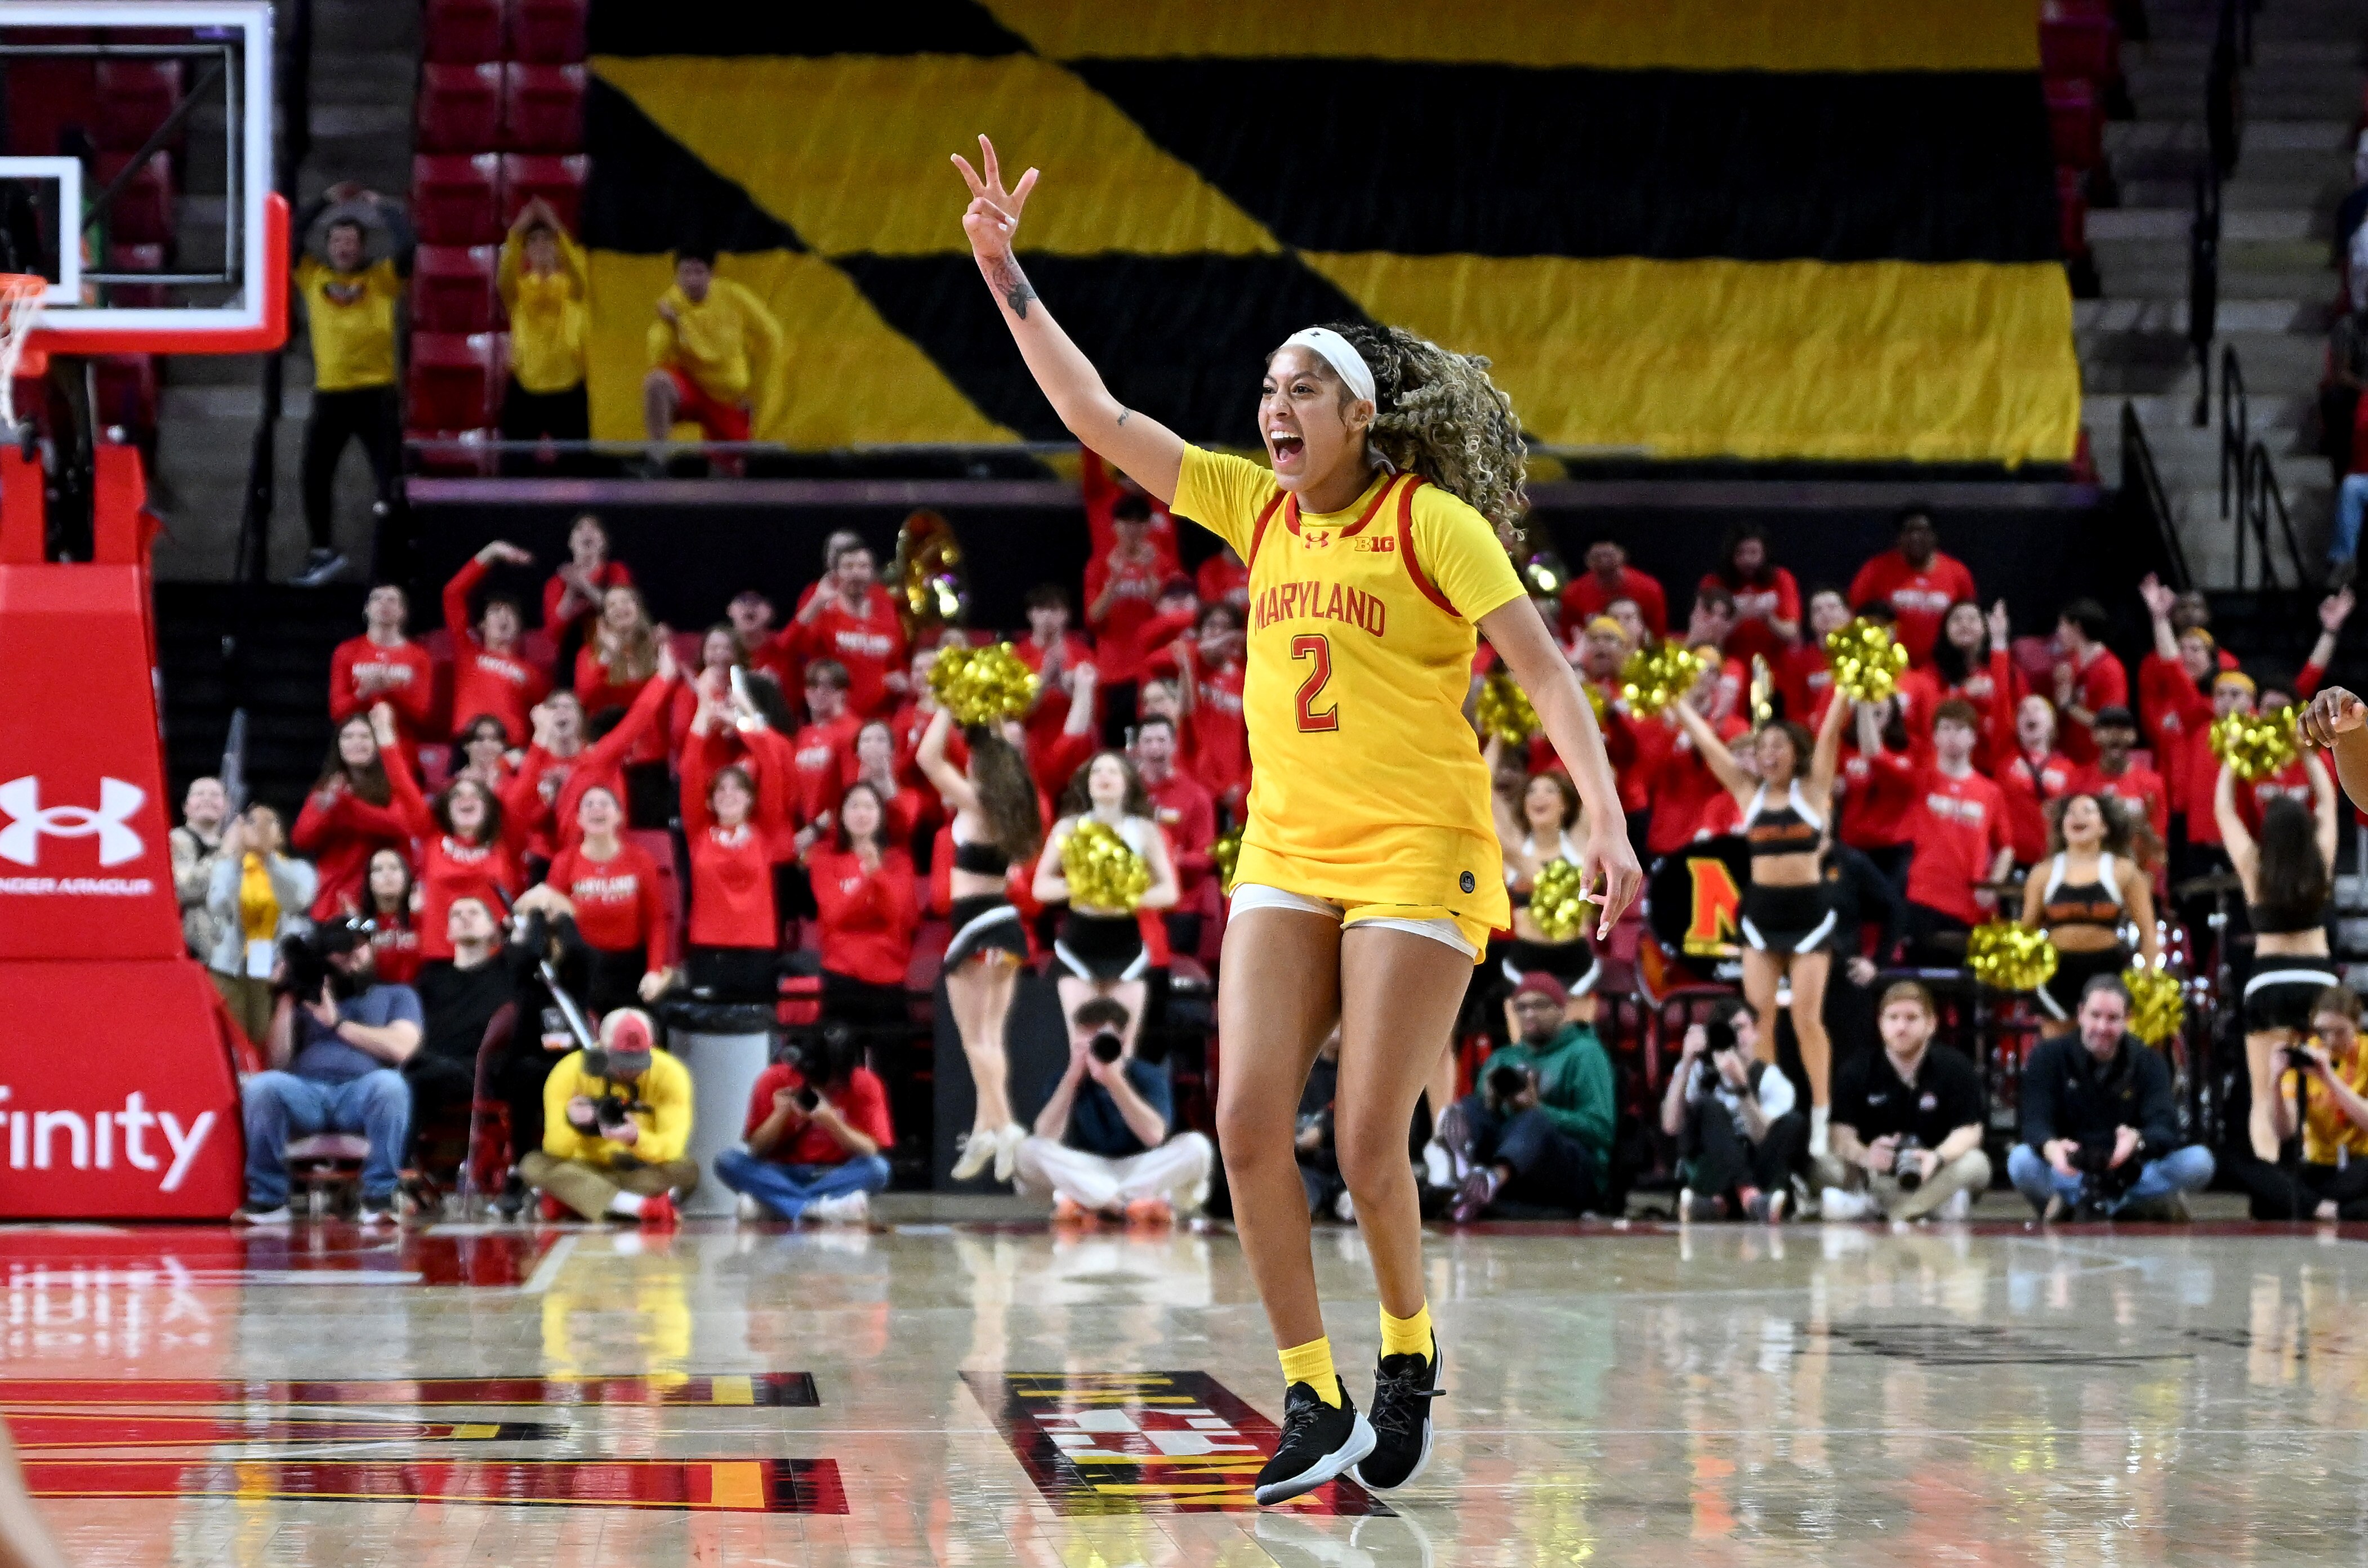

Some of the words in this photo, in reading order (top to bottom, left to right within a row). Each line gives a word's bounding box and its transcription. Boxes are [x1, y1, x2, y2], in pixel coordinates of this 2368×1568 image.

[1255, 580, 1386, 637] MARYLAND
[1291, 633, 1339, 732] 2
[56, 877, 154, 896] ARMOUR
